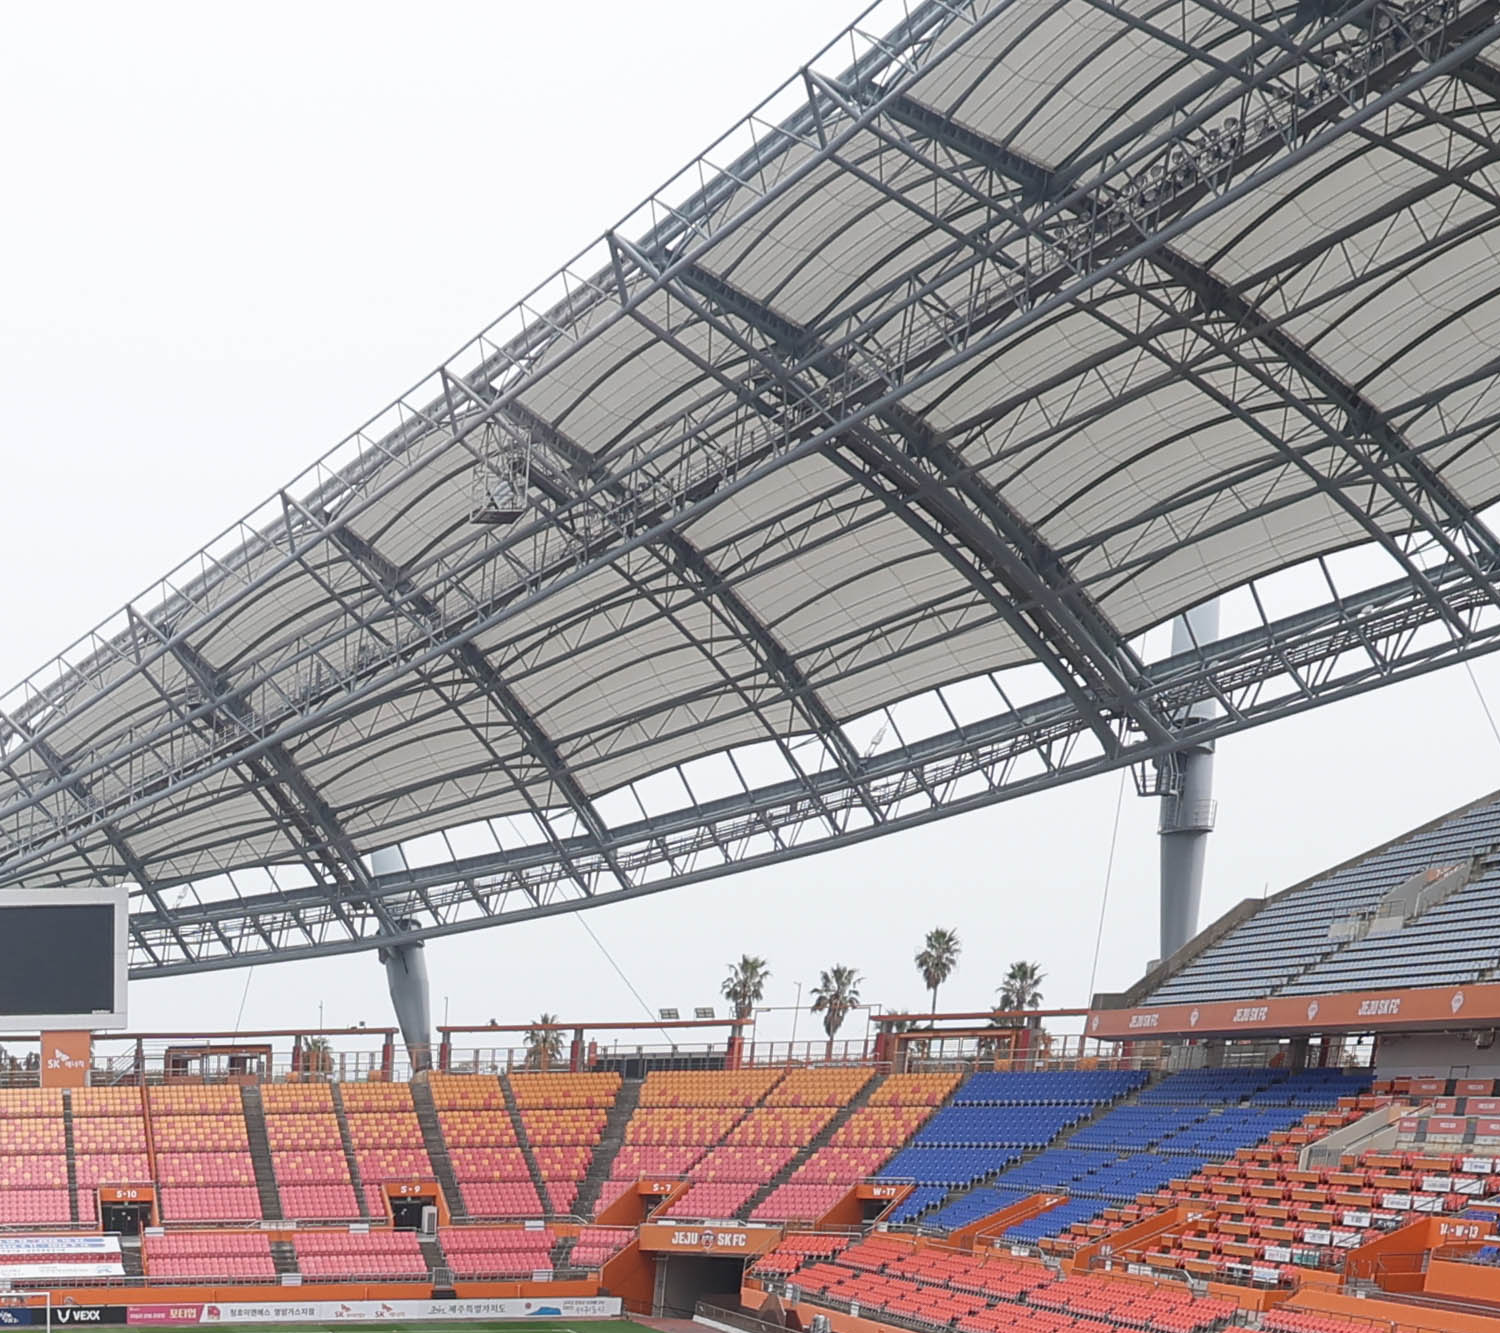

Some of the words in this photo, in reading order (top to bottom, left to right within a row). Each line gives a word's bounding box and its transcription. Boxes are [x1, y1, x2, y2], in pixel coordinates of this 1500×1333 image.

[1359, 1000, 1379, 1015] JEJU
[1378, 999, 1390, 1014] SK
[1389, 998, 1400, 1014] FC
[672, 1233, 698, 1246] JEJU
[717, 1234, 731, 1246] SK
[731, 1234, 746, 1247] FC
[72, 1310, 100, 1321] VEXX
